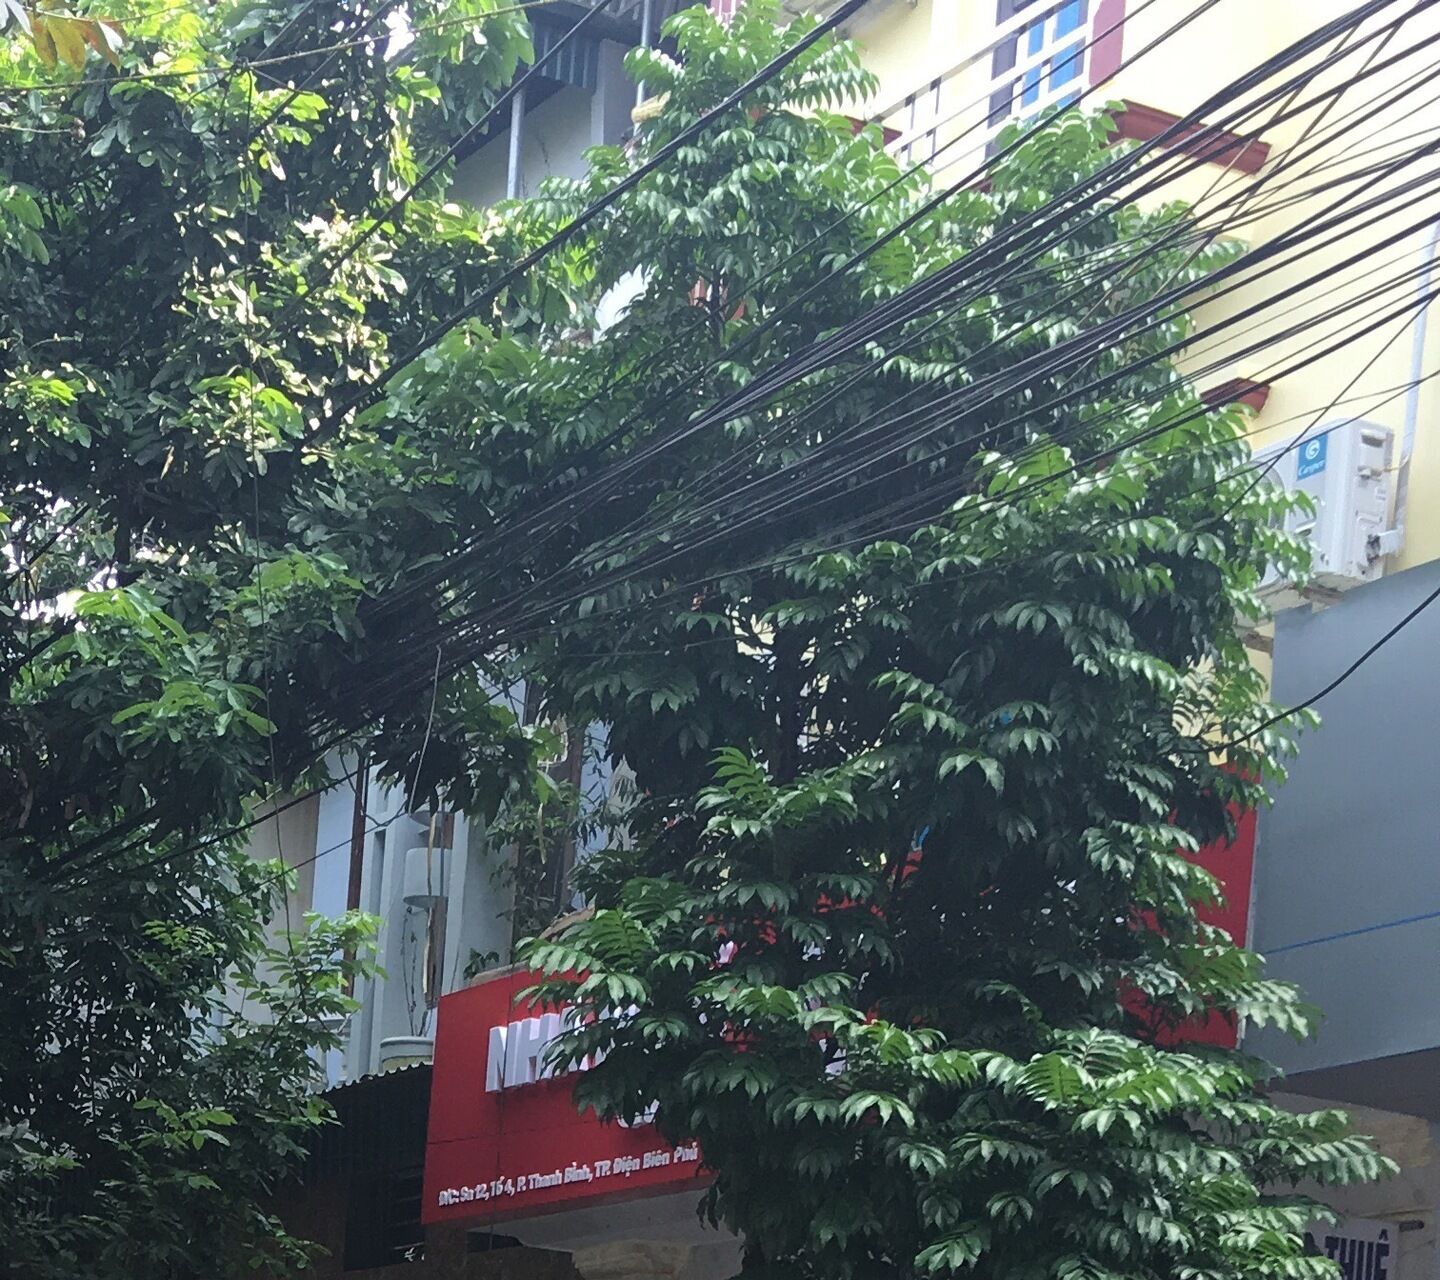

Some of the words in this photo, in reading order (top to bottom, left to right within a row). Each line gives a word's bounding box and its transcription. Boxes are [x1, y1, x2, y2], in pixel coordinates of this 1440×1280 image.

[527, 1169, 563, 1189] Thanh
[613, 1155, 640, 1177] Điện
[642, 1149, 670, 1169] Biên
